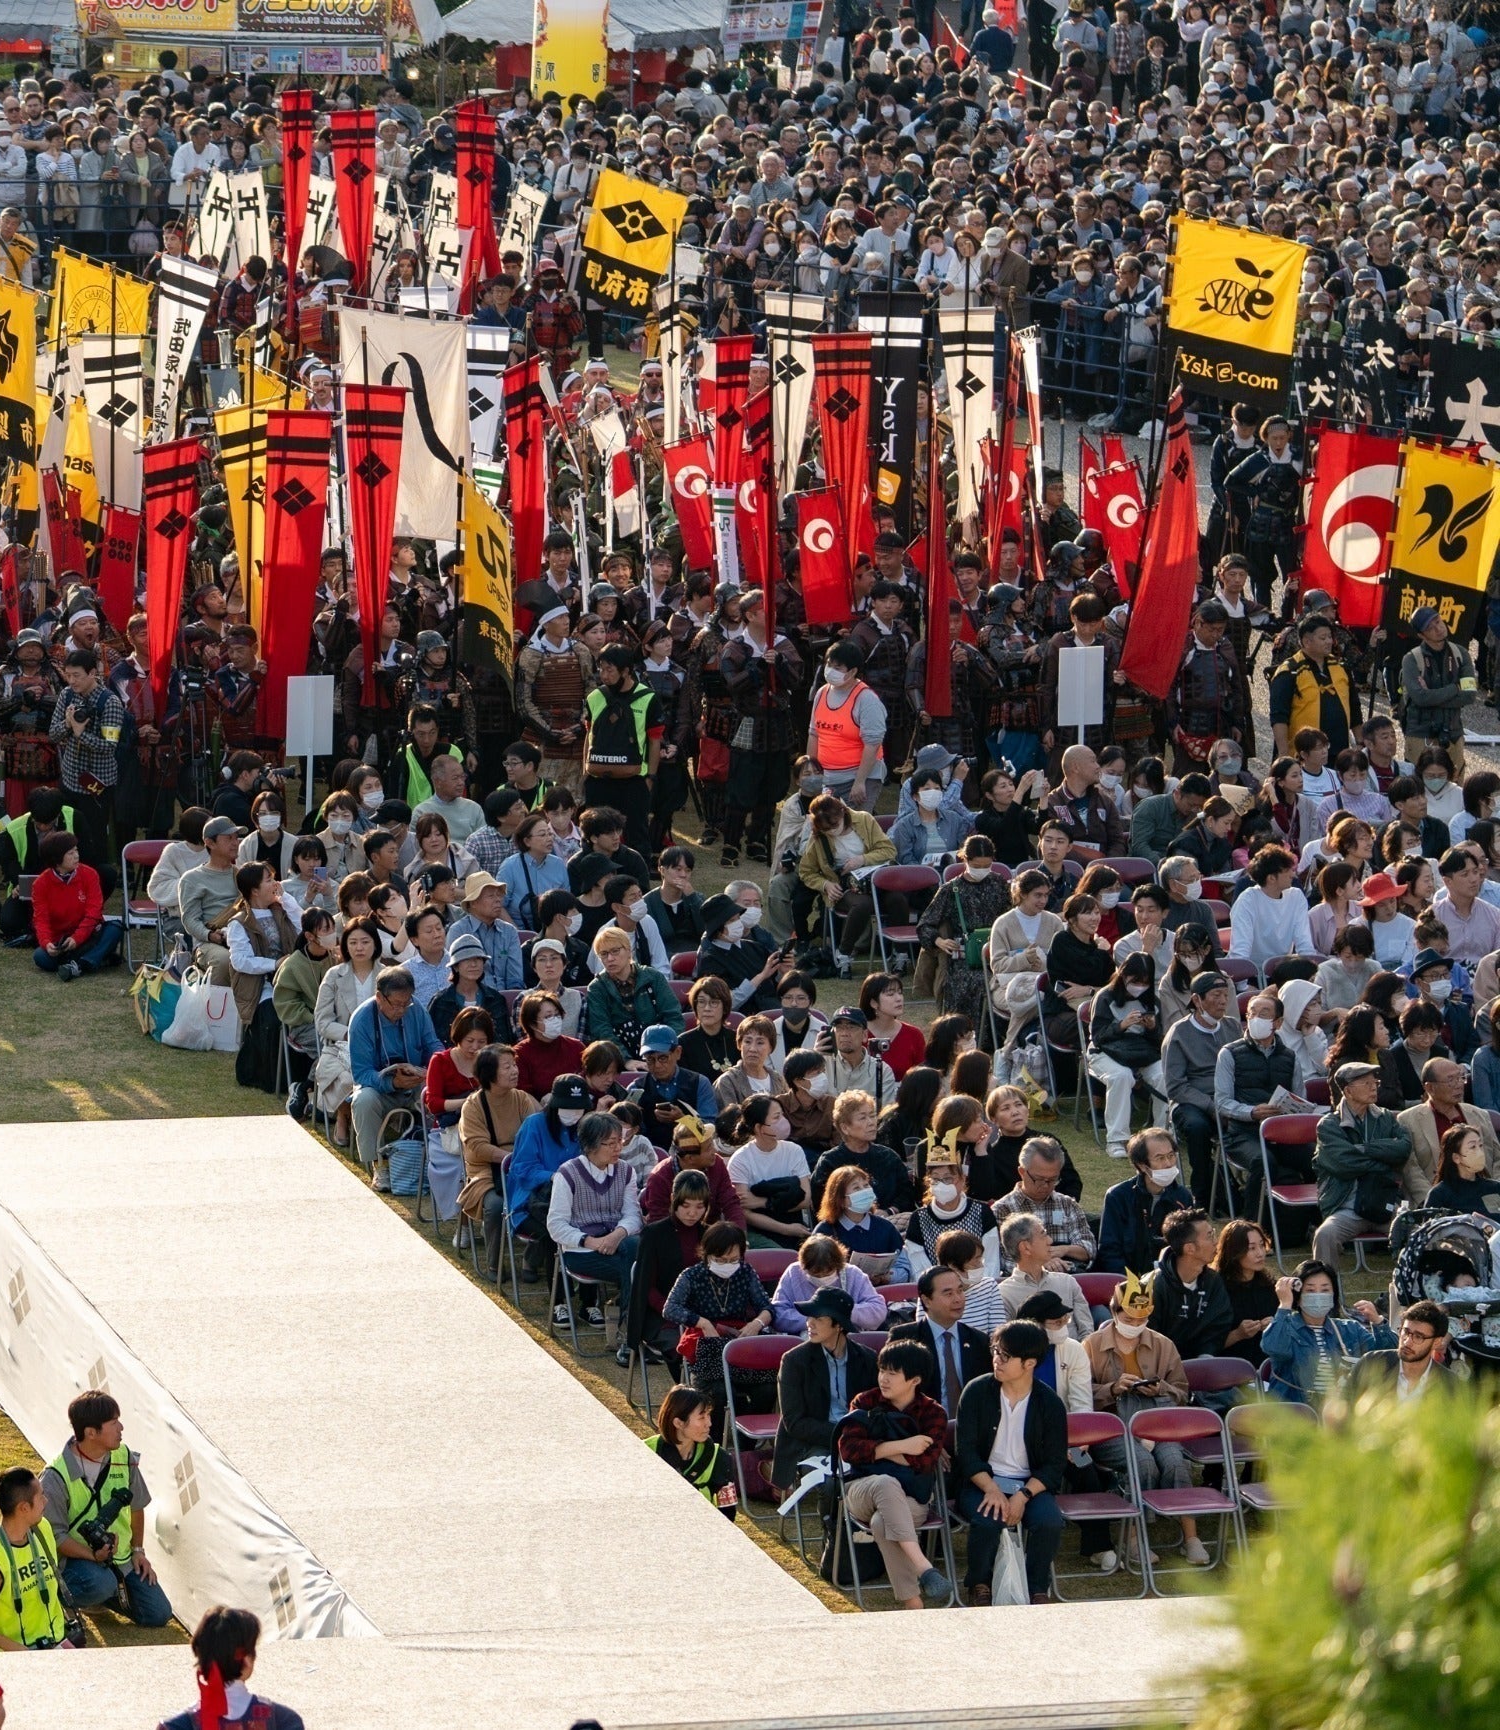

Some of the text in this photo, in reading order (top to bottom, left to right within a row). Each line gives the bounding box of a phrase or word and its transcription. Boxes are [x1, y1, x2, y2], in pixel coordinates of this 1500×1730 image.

[263, 16, 321, 25] CHOCOLATE
[585, 260, 650, 307] 甲府市
[1180, 353, 1214, 379] Ysk
